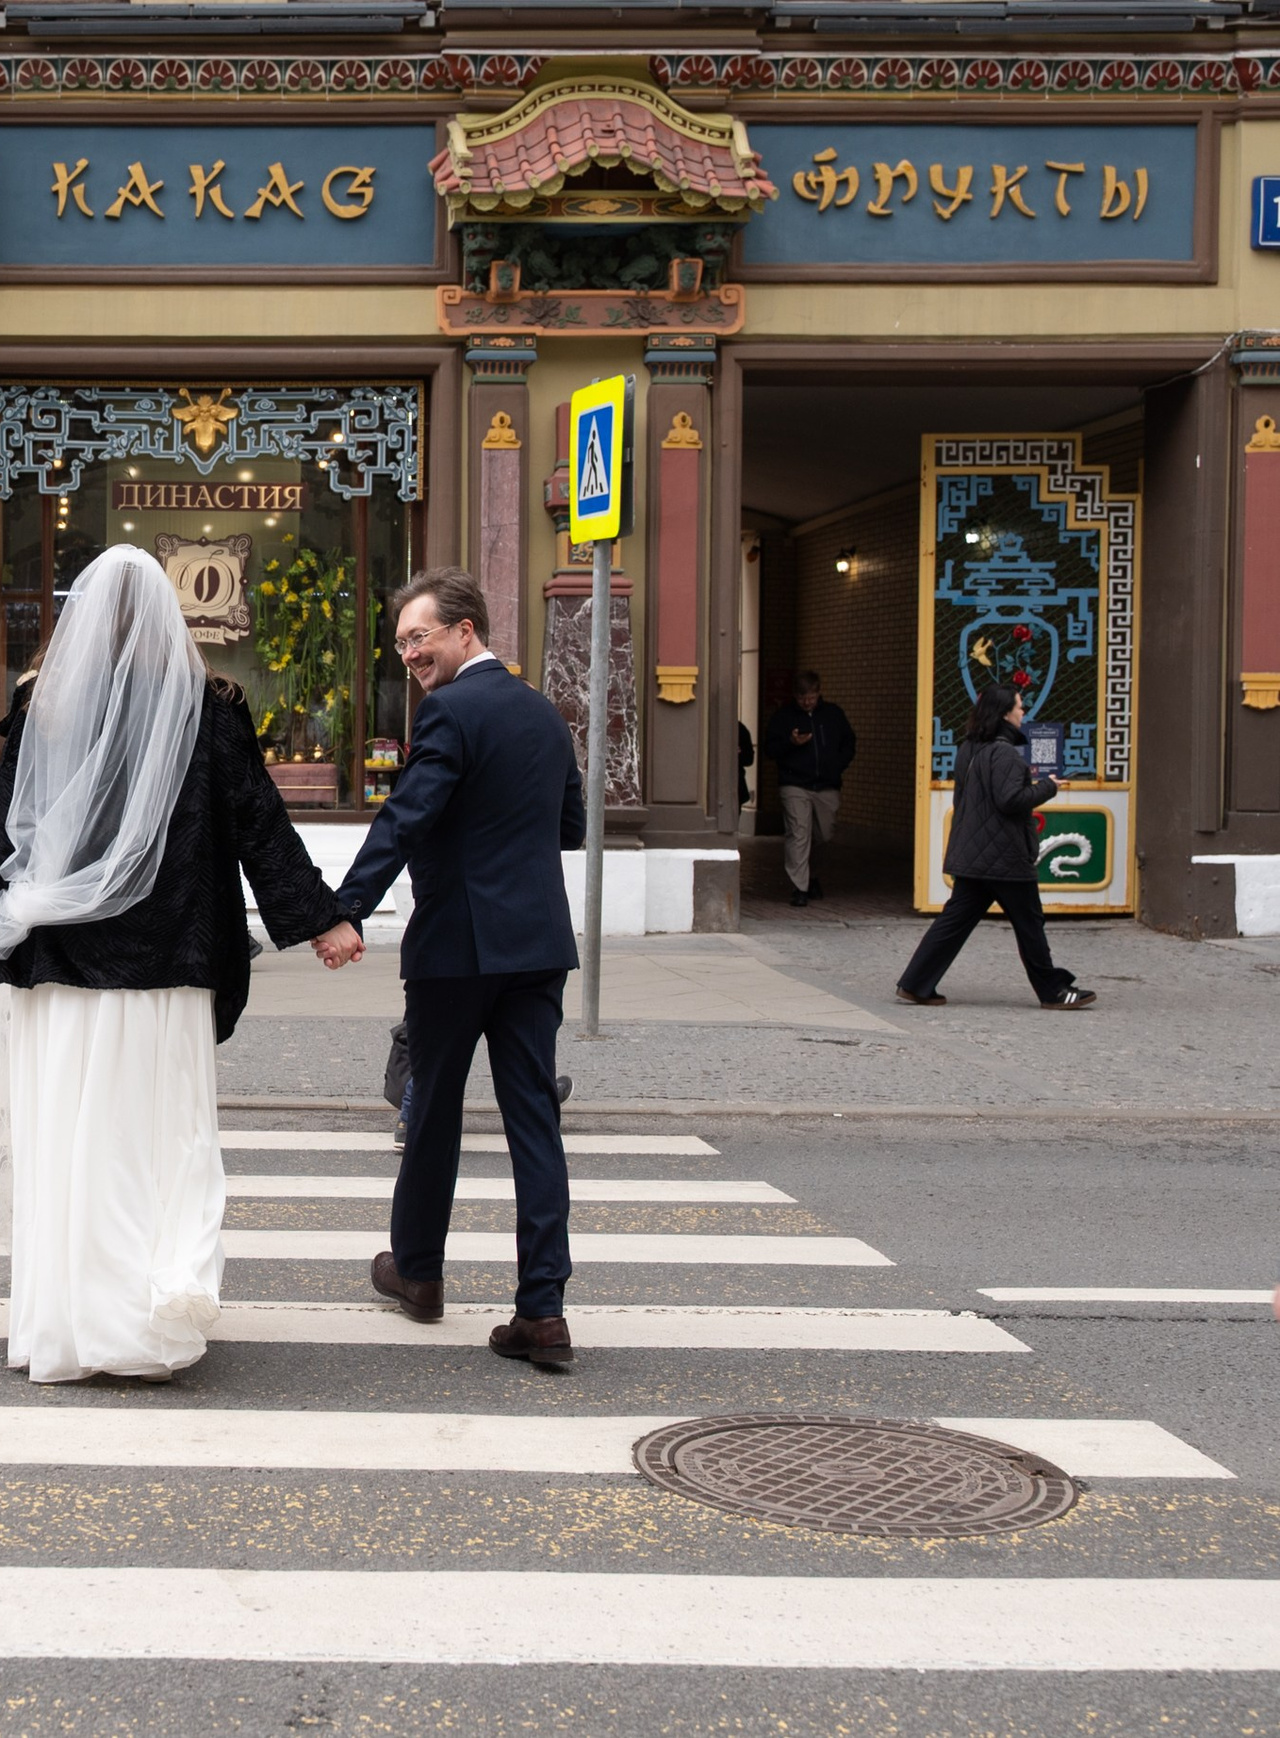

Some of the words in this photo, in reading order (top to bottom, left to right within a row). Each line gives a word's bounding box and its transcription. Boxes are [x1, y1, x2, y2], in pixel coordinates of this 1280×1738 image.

[51, 158, 377, 219] КАКАО
[792, 147, 1149, 221] ФРУКТЫ
[118, 484, 303, 511] ДИНАСТИЯ
[191, 630, 220, 640] ОФЕ
